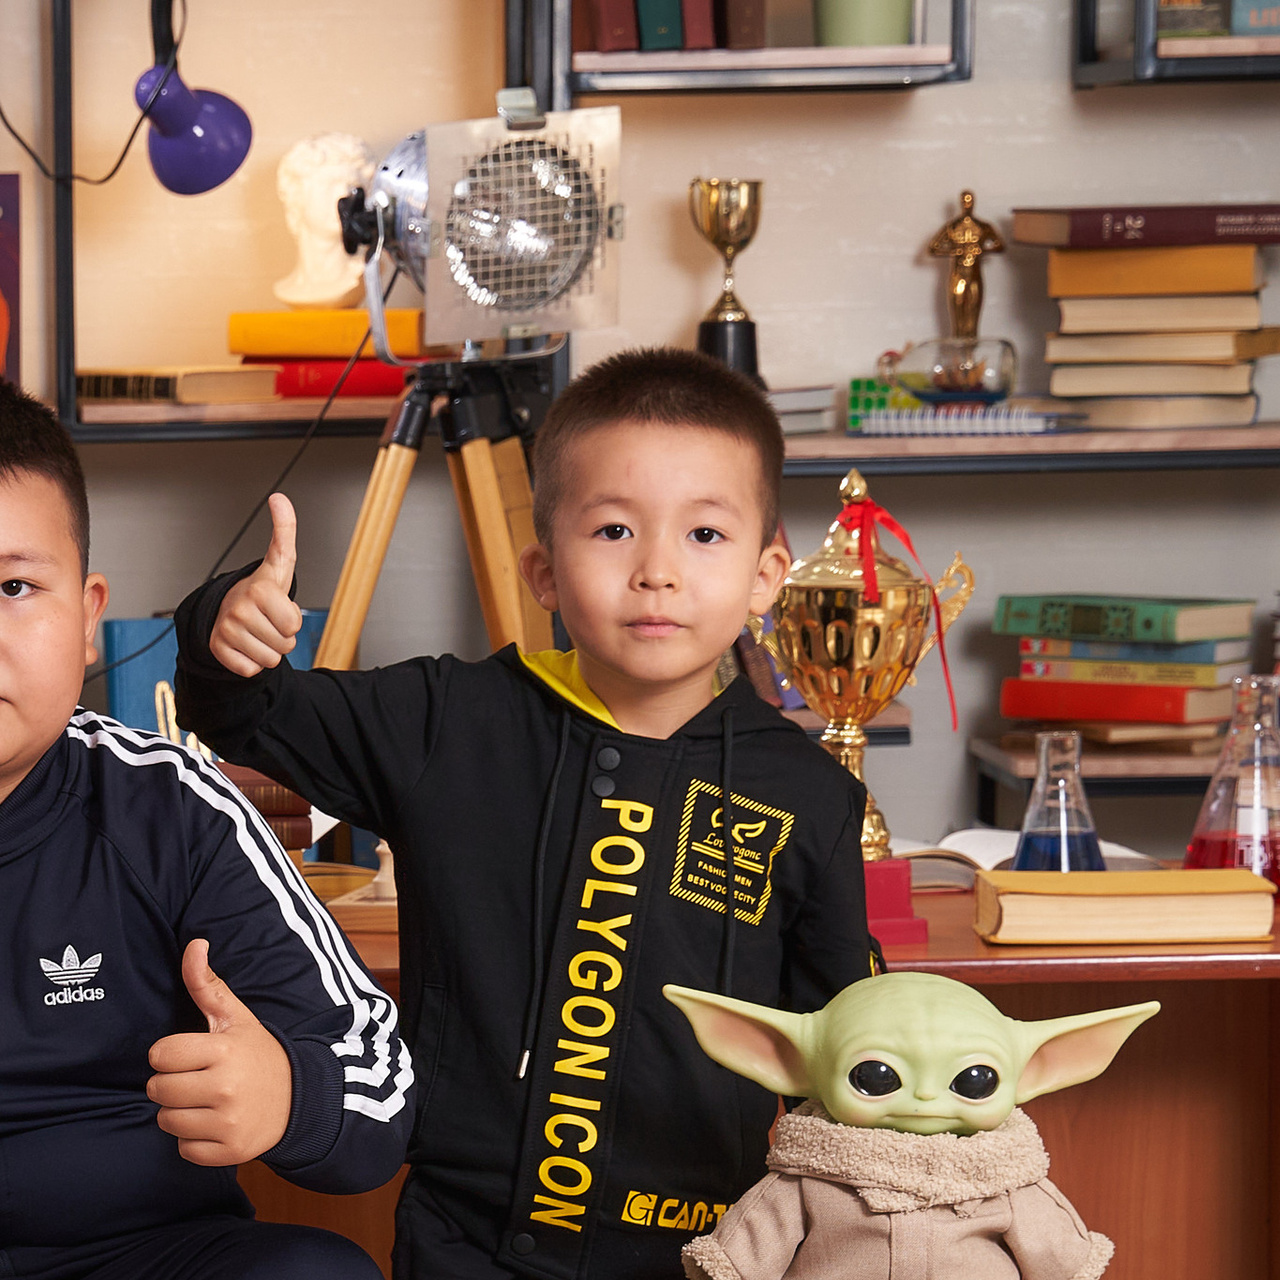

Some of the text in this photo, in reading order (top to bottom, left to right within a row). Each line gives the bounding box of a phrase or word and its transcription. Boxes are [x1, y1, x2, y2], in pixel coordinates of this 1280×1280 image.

[686, 873, 710, 889] BEST
[734, 874, 752, 888] MEN
[43, 985, 105, 1006] adidas
[529, 797, 655, 1234] POLYGON ICON
